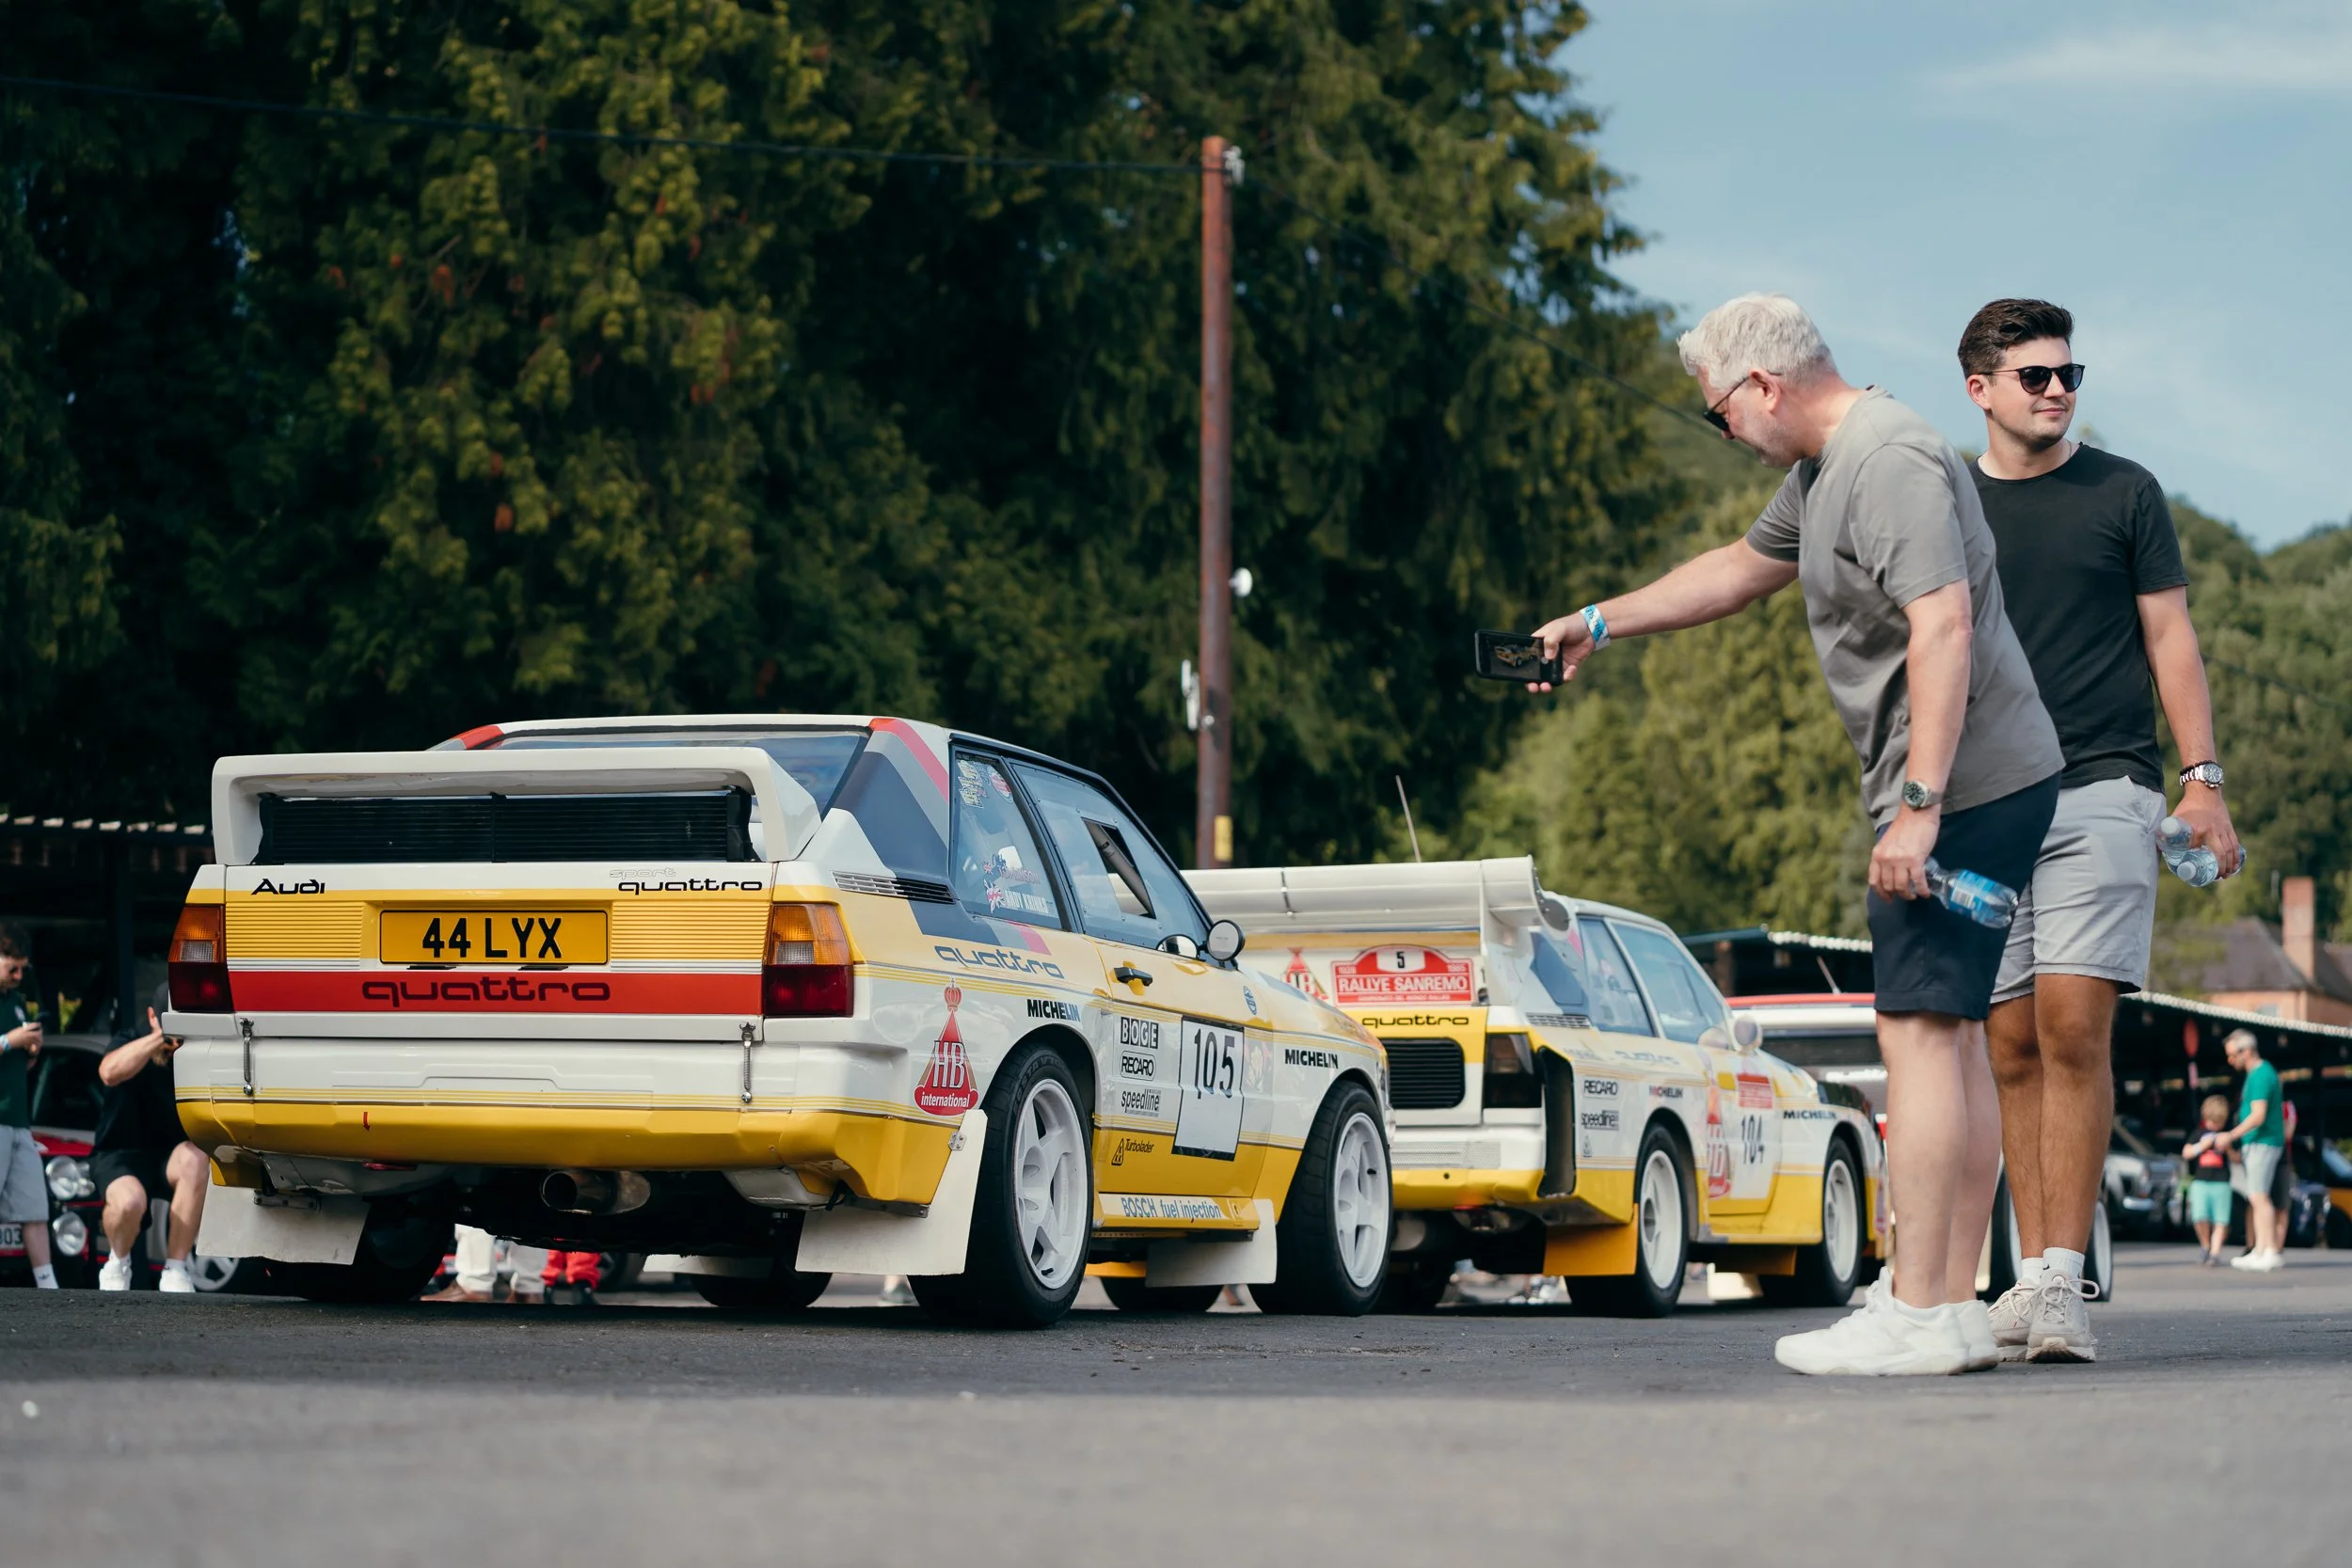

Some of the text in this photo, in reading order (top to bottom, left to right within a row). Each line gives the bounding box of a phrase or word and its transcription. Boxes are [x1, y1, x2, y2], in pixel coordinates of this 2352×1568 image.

[610, 867, 675, 879] sport
[251, 878, 326, 895] Audi
[618, 879, 763, 895] quattro
[422, 917, 562, 958] 44 LYX
[934, 945, 1065, 979] quattro
[1396, 951, 1406, 969] 5
[362, 974, 611, 1007] quattro
[1340, 975, 1468, 992] RALLYE SANREMO
[1027, 999, 1081, 1022] MICHELIN
[1362, 1015, 1470, 1028] quattro
[1120, 1017, 1159, 1049] BOGE
[932, 1040, 966, 1088] HB
[1121, 1056, 1154, 1076] RECARO
[1195, 1028, 1235, 1099] 105
[1285, 1049, 1339, 1069] MICHELIN
[1584, 1080, 1618, 1095] RECARO
[1649, 1085, 1683, 1099] MICHELIN
[921, 1092, 970, 1107] international
[1121, 1088, 1159, 1113] speedline
[1783, 1110, 1836, 1119] MICHELIN
[1125, 1139, 1154, 1152] Turbolader
[1741, 1115, 1765, 1164] 104
[1121, 1197, 1221, 1219] BOSCH fuel injection
[0, 1227, 23, 1244] 03
